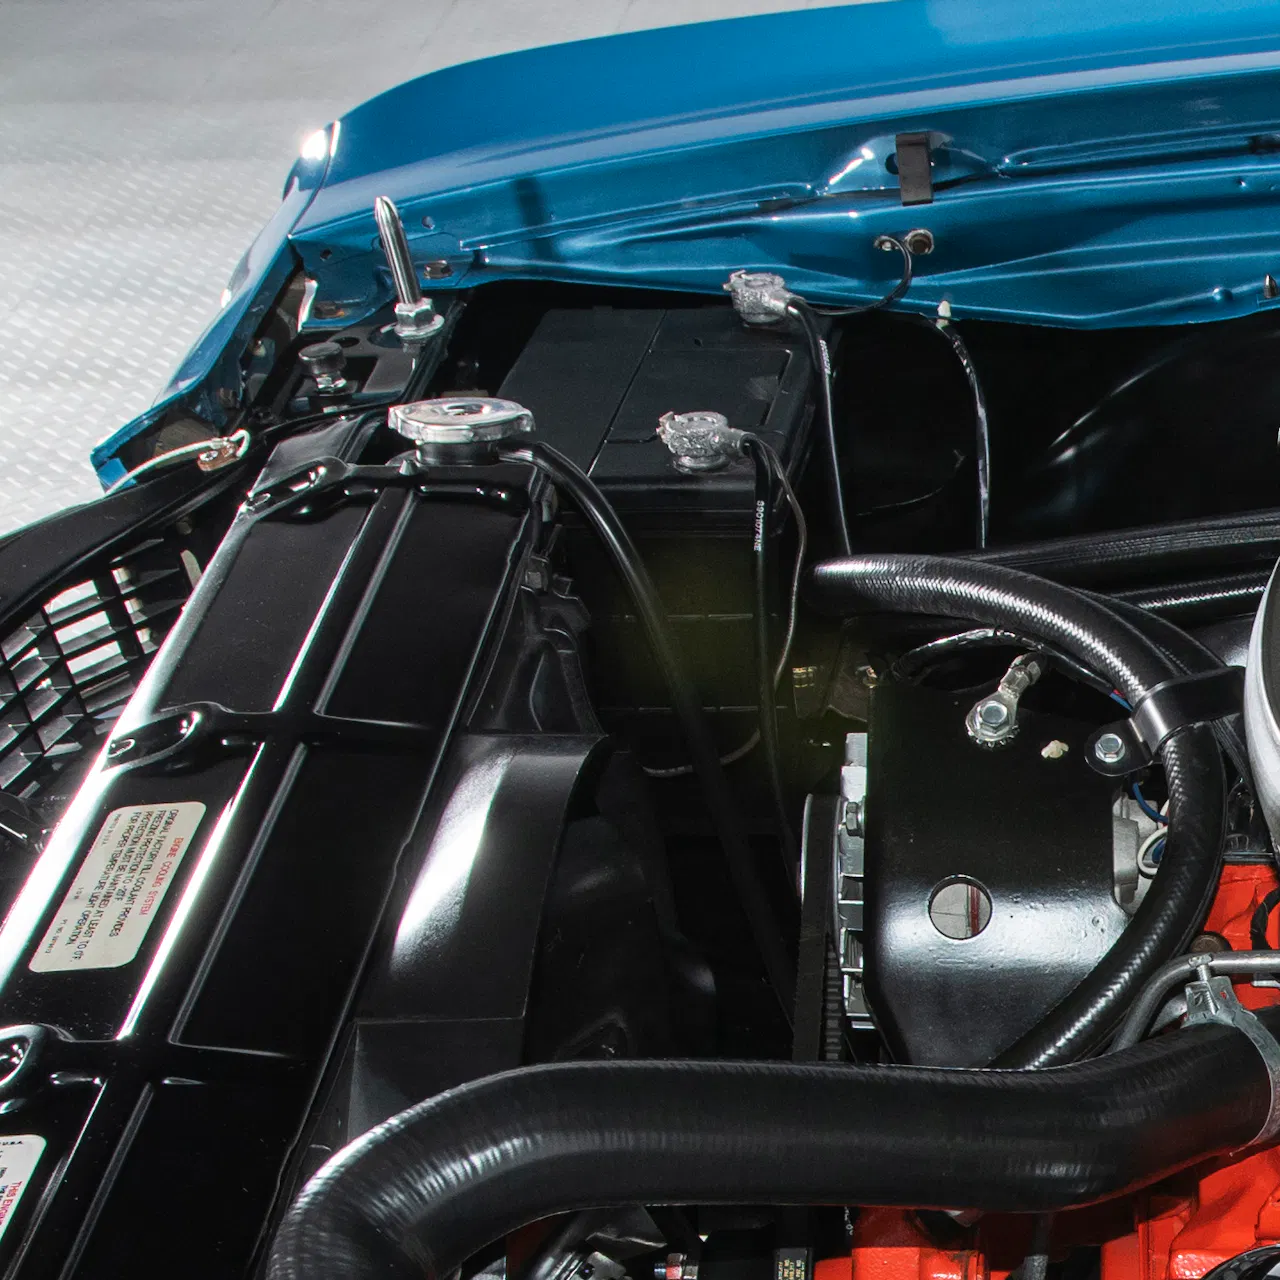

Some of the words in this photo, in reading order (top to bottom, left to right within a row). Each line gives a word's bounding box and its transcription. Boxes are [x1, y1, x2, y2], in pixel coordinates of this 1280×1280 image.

[117, 824, 134, 847] PROPER
[130, 810, 154, 846] PROTECTION
[147, 809, 166, 836] FREEZING
[128, 837, 152, 873] PROTECTION
[146, 835, 166, 862] FACTORY
[168, 837, 184, 857] ENGINE
[95, 849, 122, 890] TEMPERATURE
[153, 861, 172, 887] COOLING
[125, 877, 146, 905] COOLANT
[139, 891, 158, 915] SYSTEM
[83, 919, 100, 937] LEAST
[110, 907, 131, 937] PROVIDES
